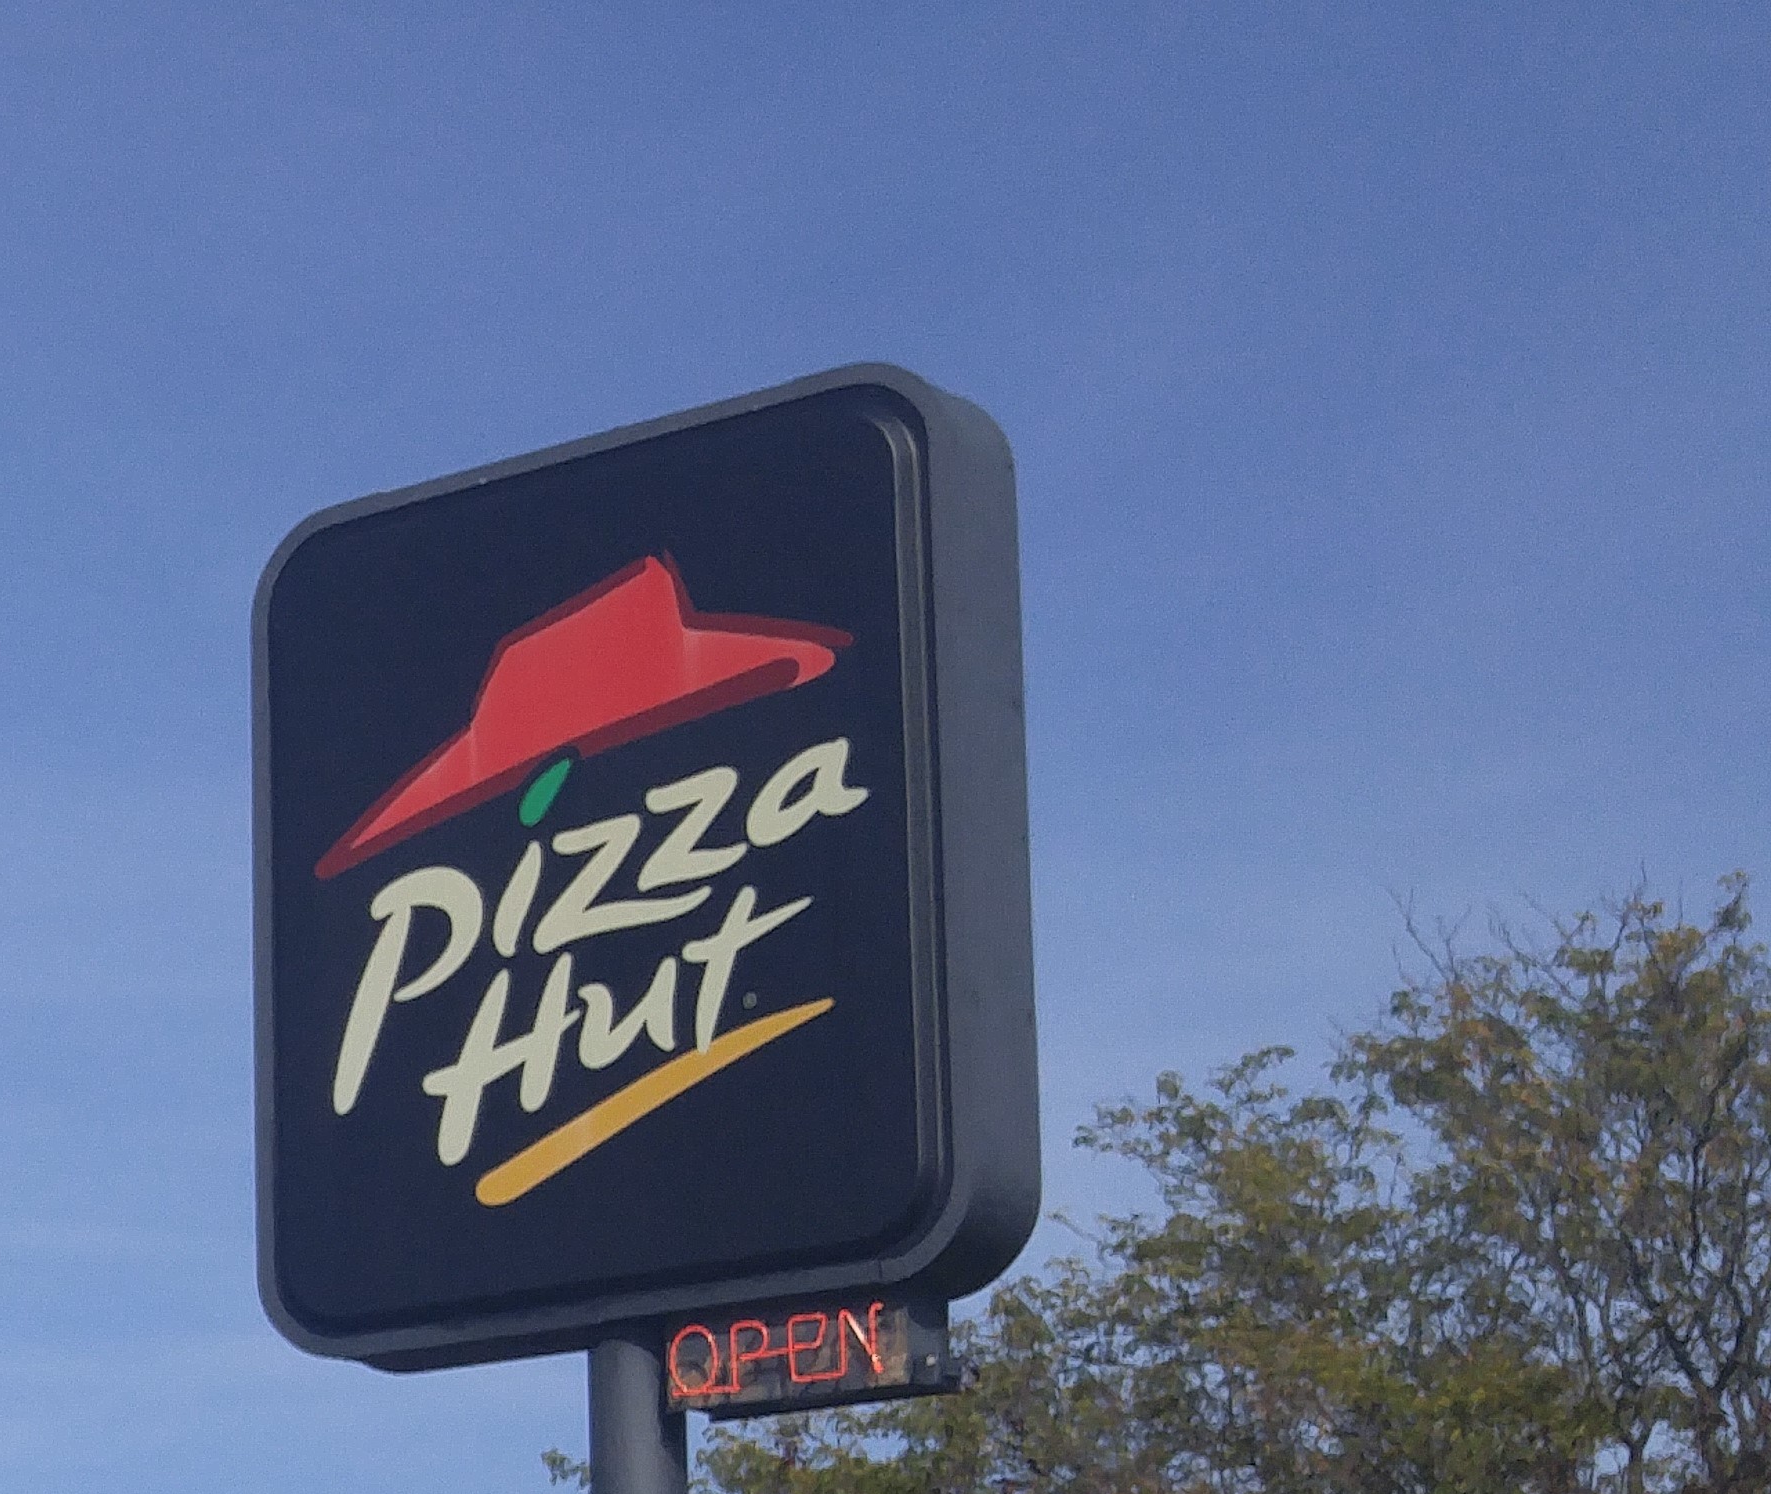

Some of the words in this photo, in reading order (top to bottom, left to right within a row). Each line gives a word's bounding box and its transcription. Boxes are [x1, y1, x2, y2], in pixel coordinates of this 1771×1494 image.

[333, 736, 870, 1116] Pizza
[421, 886, 813, 1166] Hut
[668, 1300, 885, 1398] OPEN
